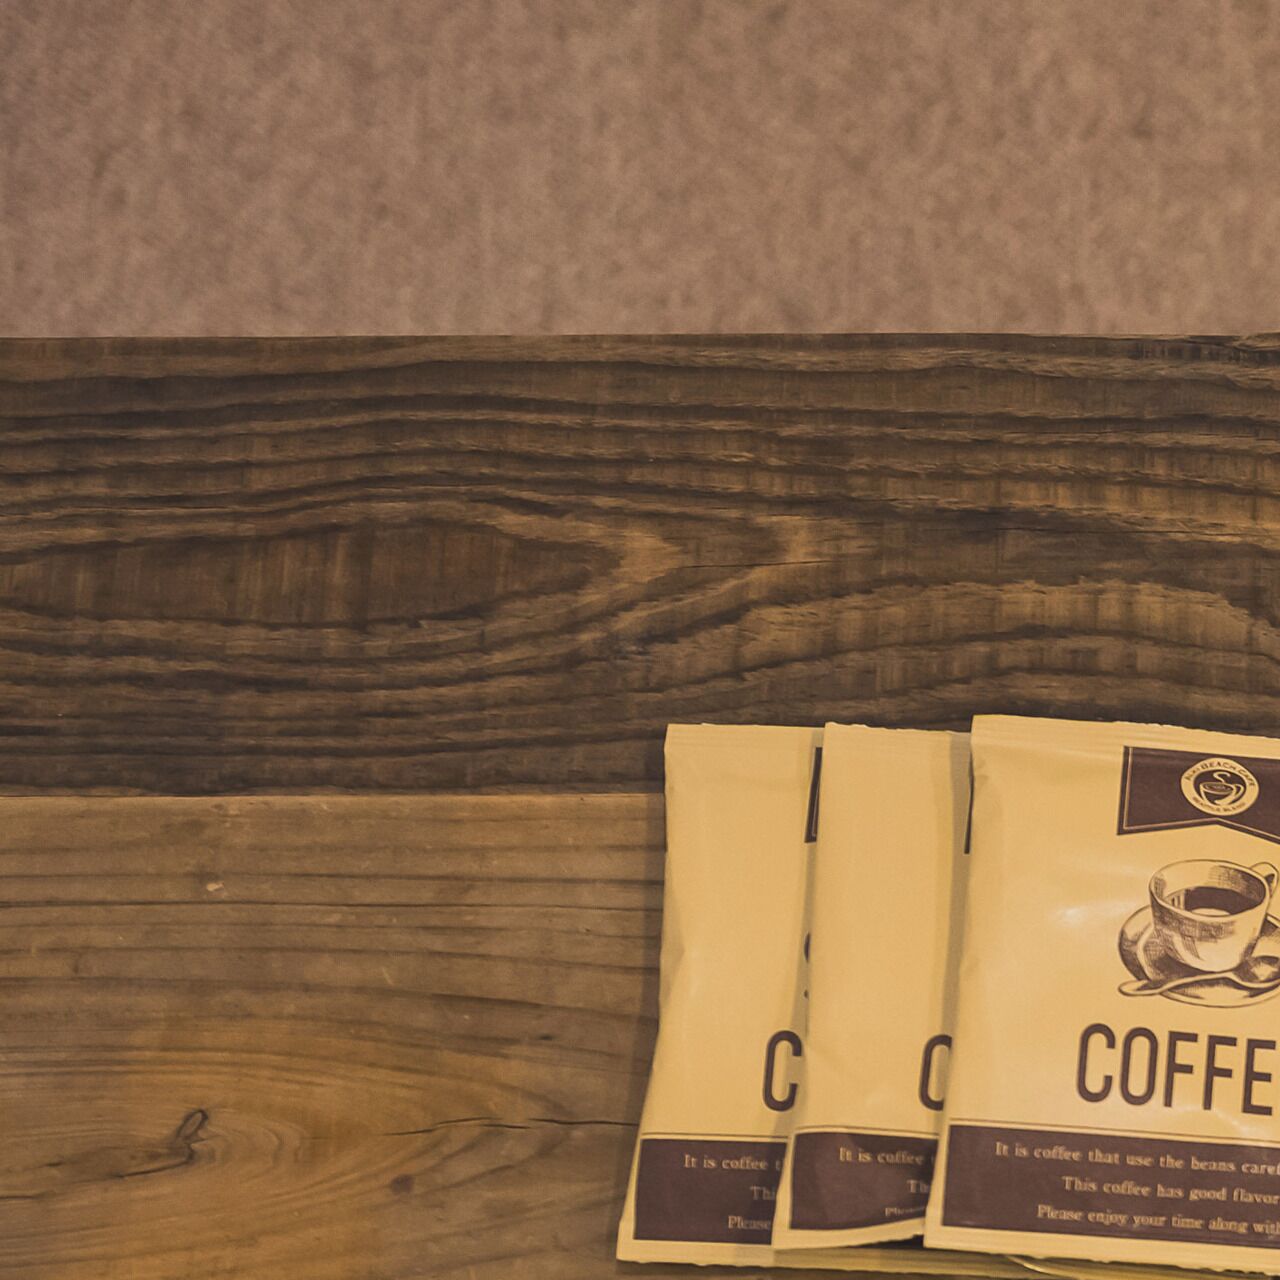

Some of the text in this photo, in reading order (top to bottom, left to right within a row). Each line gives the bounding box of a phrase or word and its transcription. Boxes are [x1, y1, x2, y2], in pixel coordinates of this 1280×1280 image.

[684, 1154, 697, 1169] It
[703, 1155, 716, 1169] is
[721, 1156, 769, 1171] coffee
[857, 1148, 872, 1163] is
[877, 1149, 925, 1166] coffee
[995, 1141, 1009, 1157] It
[1015, 1142, 1029, 1157] is
[1034, 1145, 1083, 1161] coffee
[1088, 1148, 1120, 1165] that
[1126, 1153, 1154, 1167] use
[1159, 1152, 1185, 1169] the
[1191, 1156, 1236, 1172] beans
[1061, 1175, 1098, 1193] This
[1102, 1179, 1152, 1198] coffee
[1156, 1183, 1185, 1199] has
[1189, 1187, 1228, 1202] good
[1036, 1203, 1084, 1222] Please
[1087, 1208, 1129, 1227] enjoy
[1131, 1213, 1167, 1229] your
[1170, 1213, 1205, 1230] time
[1208, 1216, 1249, 1236] along
